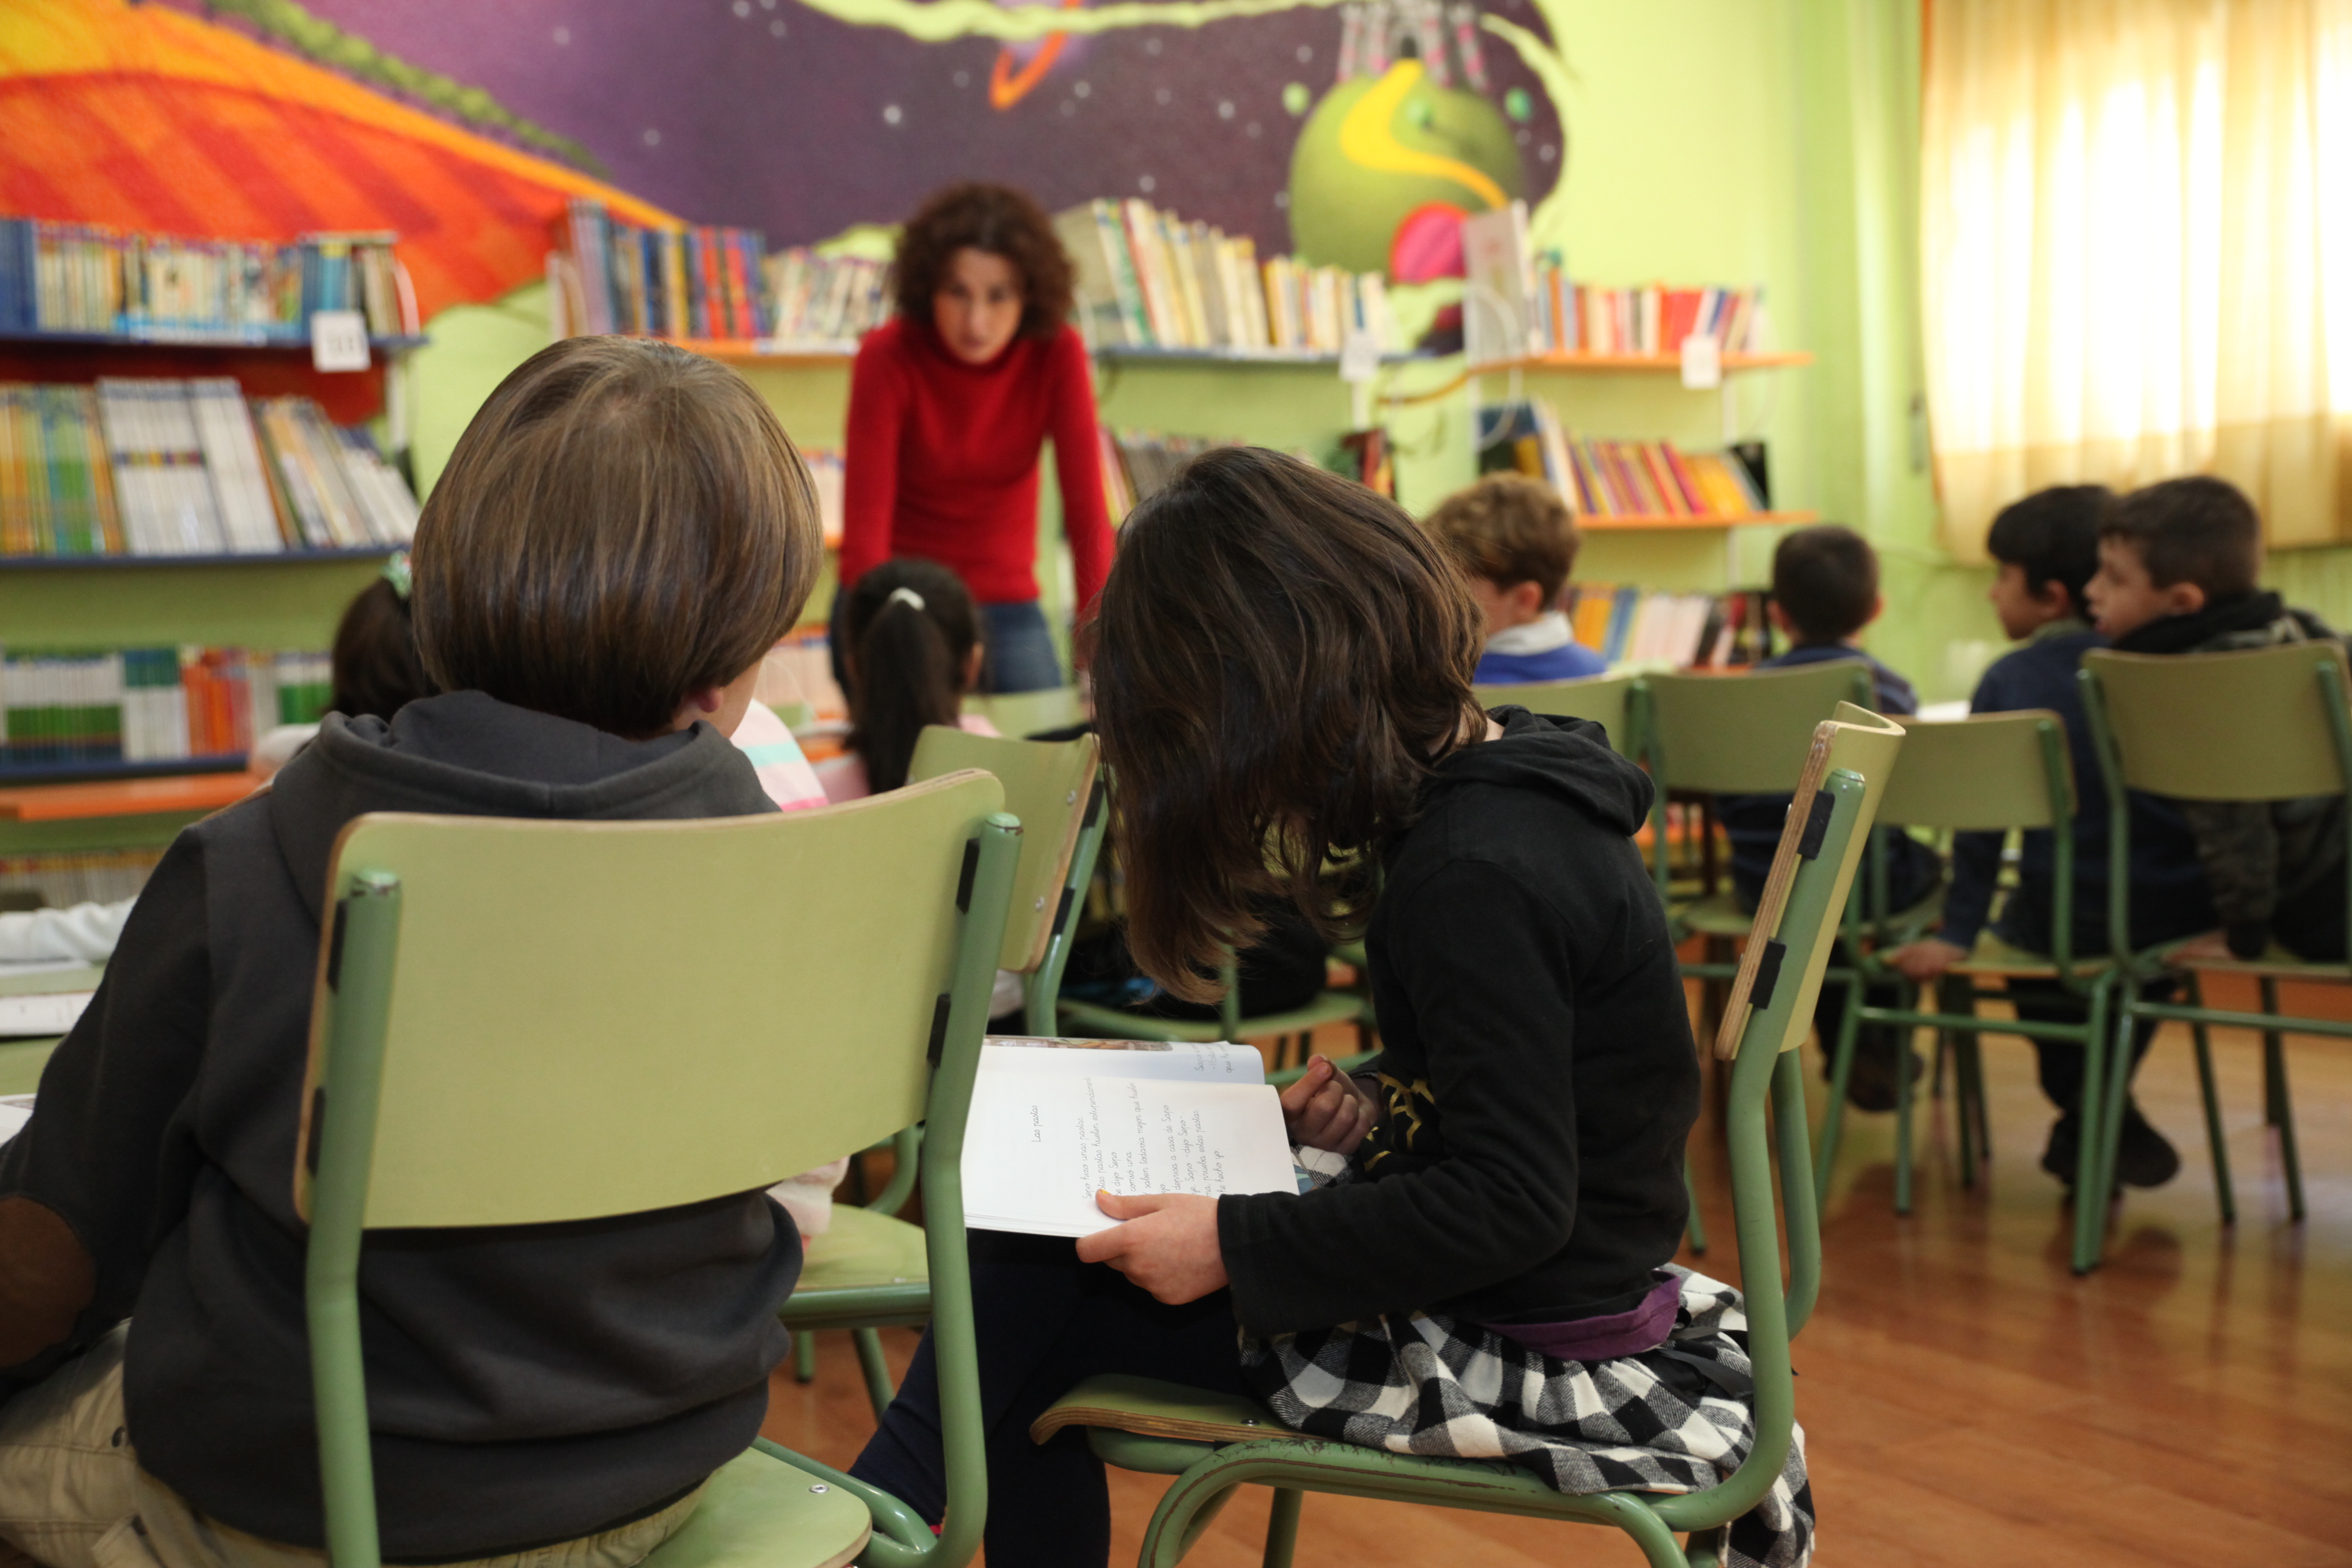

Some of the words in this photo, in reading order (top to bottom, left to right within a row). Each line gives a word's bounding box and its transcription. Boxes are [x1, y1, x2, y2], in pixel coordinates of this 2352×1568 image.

[1030, 1105, 1043, 1126] pastas
[1133, 1101, 1144, 1112] que
[1162, 1103, 1174, 1122] Sapo.
[1076, 1116, 1090, 1140] pastas.
[1134, 1115, 1147, 1133] mejor
[1031, 1129, 1041, 1142] Las
[1090, 1124, 1102, 1146] huelen
[1194, 1136, 1205, 1152] estas
[1108, 1150, 1121, 1169] Sepo.
[1137, 1137, 1148, 1164] todavía
[1213, 1148, 1224, 1159] yo.
[1094, 1150, 1108, 1173] pastas
[1197, 1156, 1213, 1181] prueba
[1080, 1164, 1090, 1179] hizo
[1110, 1172, 1124, 1186] dijo
[1140, 1167, 1151, 1189] saben
[1169, 1163, 1183, 1190] deprisa
[1185, 1163, 1197, 1181] Sapo
[1213, 1163, 1224, 1182] hecho
[1095, 1177, 1106, 1189] stas
[1126, 1170, 1136, 1192] comió
[1160, 1182, 1170, 1193] ijo.
[1190, 1185, 1200, 1194] ye,
[1081, 1183, 1095, 1199] Sepo
